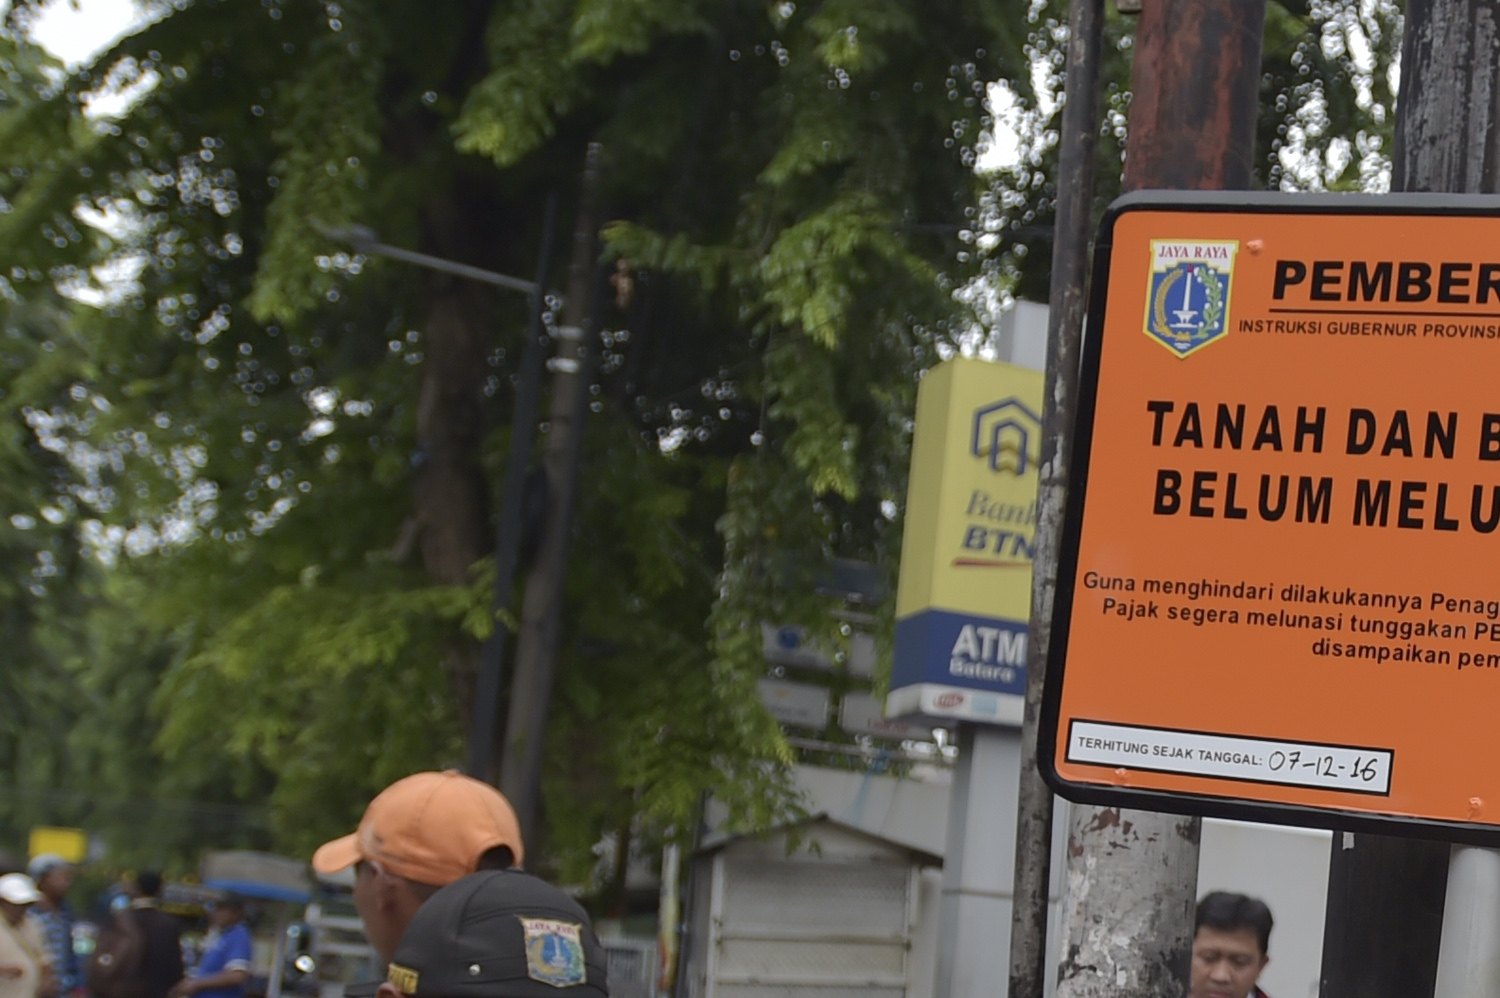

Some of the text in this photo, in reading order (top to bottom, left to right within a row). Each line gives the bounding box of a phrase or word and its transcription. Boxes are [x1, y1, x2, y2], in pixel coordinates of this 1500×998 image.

[1158, 245, 1229, 260] JAYA RAYA
[1239, 319, 1322, 335] INSTRUKSI
[1326, 321, 1417, 337] GUBERNUR
[1146, 400, 1327, 453] TANAH
[1345, 408, 1458, 460] DAN
[1153, 469, 1333, 524] BELUM
[962, 525, 1035, 559] BTN
[1083, 571, 1136, 592] Guna
[1142, 578, 1274, 601] menghindari
[1280, 584, 1422, 614] dilakukannya
[1102, 597, 1159, 621] Pajak
[1167, 606, 1239, 627] segera
[1246, 609, 1343, 631] melunasi
[1350, 615, 1467, 641] tunggakan
[951, 624, 1029, 668] ATM
[1312, 637, 1451, 665] disampaikan
[949, 656, 1016, 685] Batara
[1078, 736, 1378, 782] TERHITUNG SEJAK TANGGAL: 07-12-16
